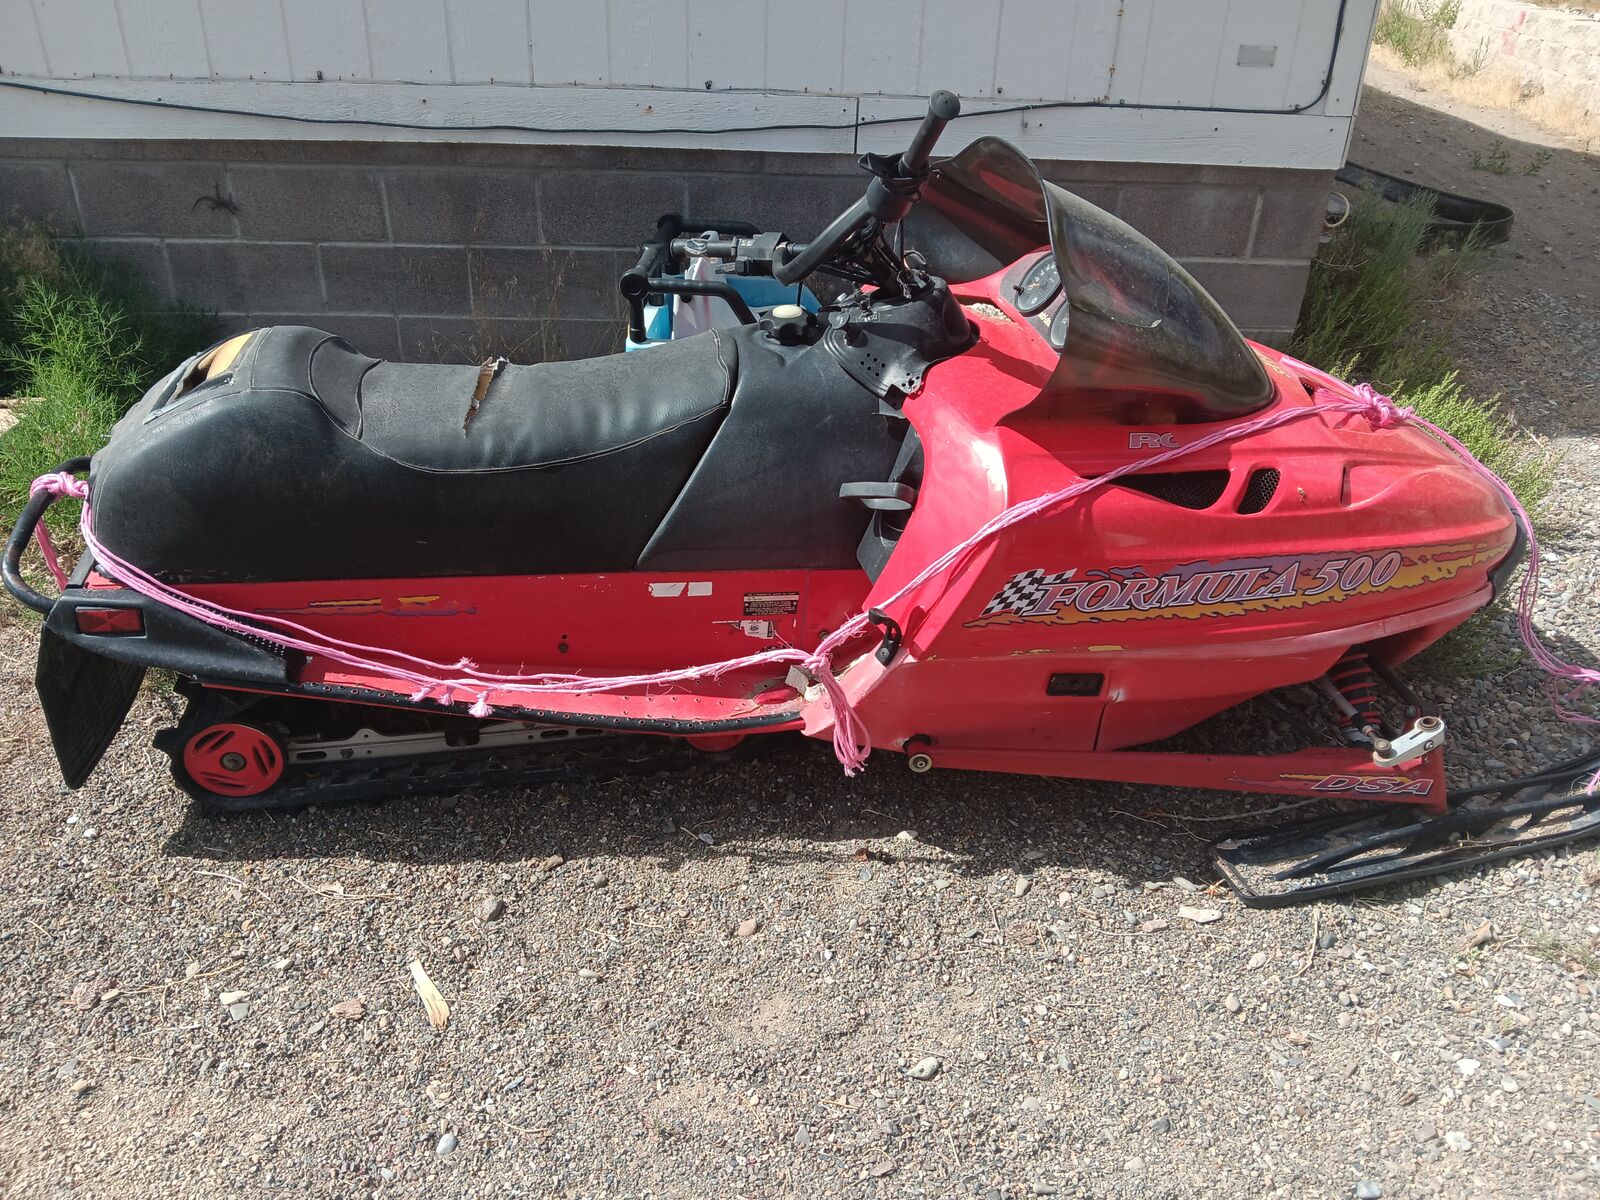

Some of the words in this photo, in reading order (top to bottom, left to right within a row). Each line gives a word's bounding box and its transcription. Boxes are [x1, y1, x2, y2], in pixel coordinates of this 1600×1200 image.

[1021, 562, 1299, 617] FORMULA
[1302, 551, 1403, 597] 500
[1310, 774, 1434, 796] DSA
